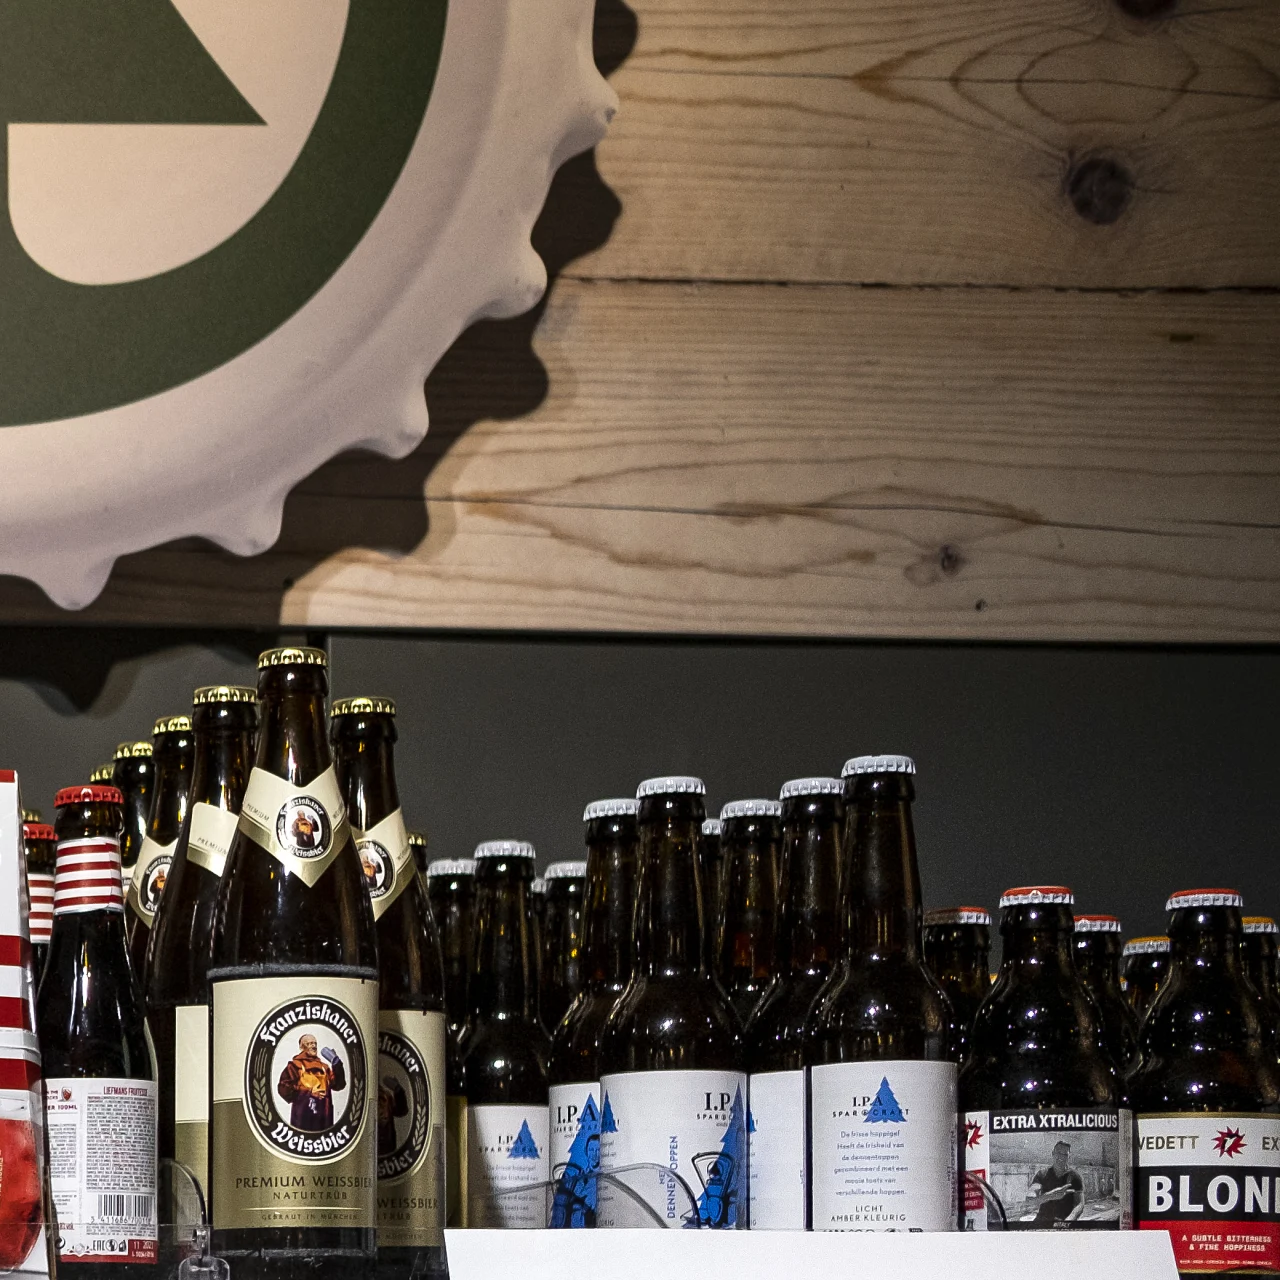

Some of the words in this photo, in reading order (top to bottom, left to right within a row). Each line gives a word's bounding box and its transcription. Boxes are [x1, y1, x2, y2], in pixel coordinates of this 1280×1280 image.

[260, 1004, 360, 1048] Franziskaner
[993, 1116, 1036, 1129] EXTRA
[1040, 1114, 1118, 1128] XTRALICIOUS
[269, 1122, 351, 1154] Weissbier
[1138, 1136, 1199, 1151] VEDETT
[236, 1176, 307, 1189] PREMIUM
[312, 1176, 373, 1189] WEISSBIER
[272, 1189, 348, 1200] NATURTRÜB
[1149, 1176, 1280, 1213] BLON
[855, 1205, 883, 1213] LICHT
[831, 1214, 864, 1223] AMBER
[867, 1213, 905, 1222] KLEURIG
